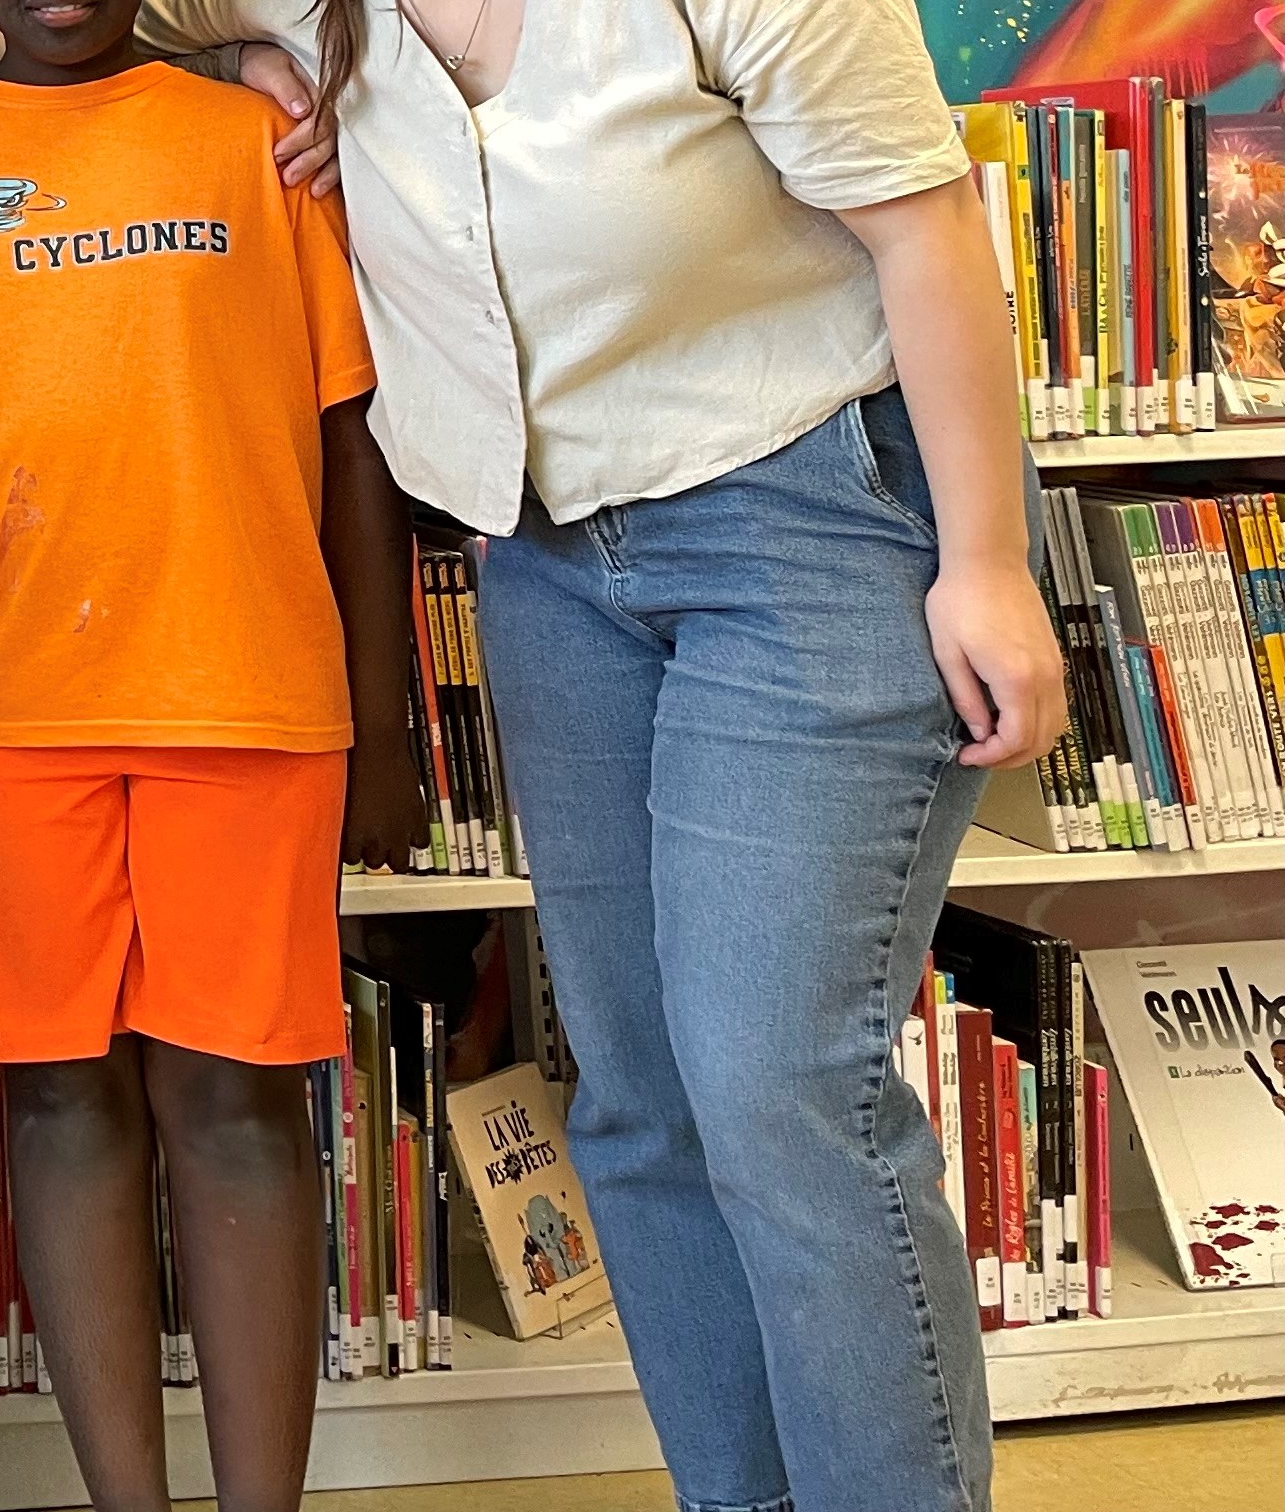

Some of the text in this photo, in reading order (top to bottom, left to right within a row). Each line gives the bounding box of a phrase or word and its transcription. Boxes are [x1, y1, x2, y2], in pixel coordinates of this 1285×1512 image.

[12, 220, 230, 273] CYCLONES
[483, 1099, 535, 1152] LA VIE
[485, 1140, 557, 1189] DES BÊTES
